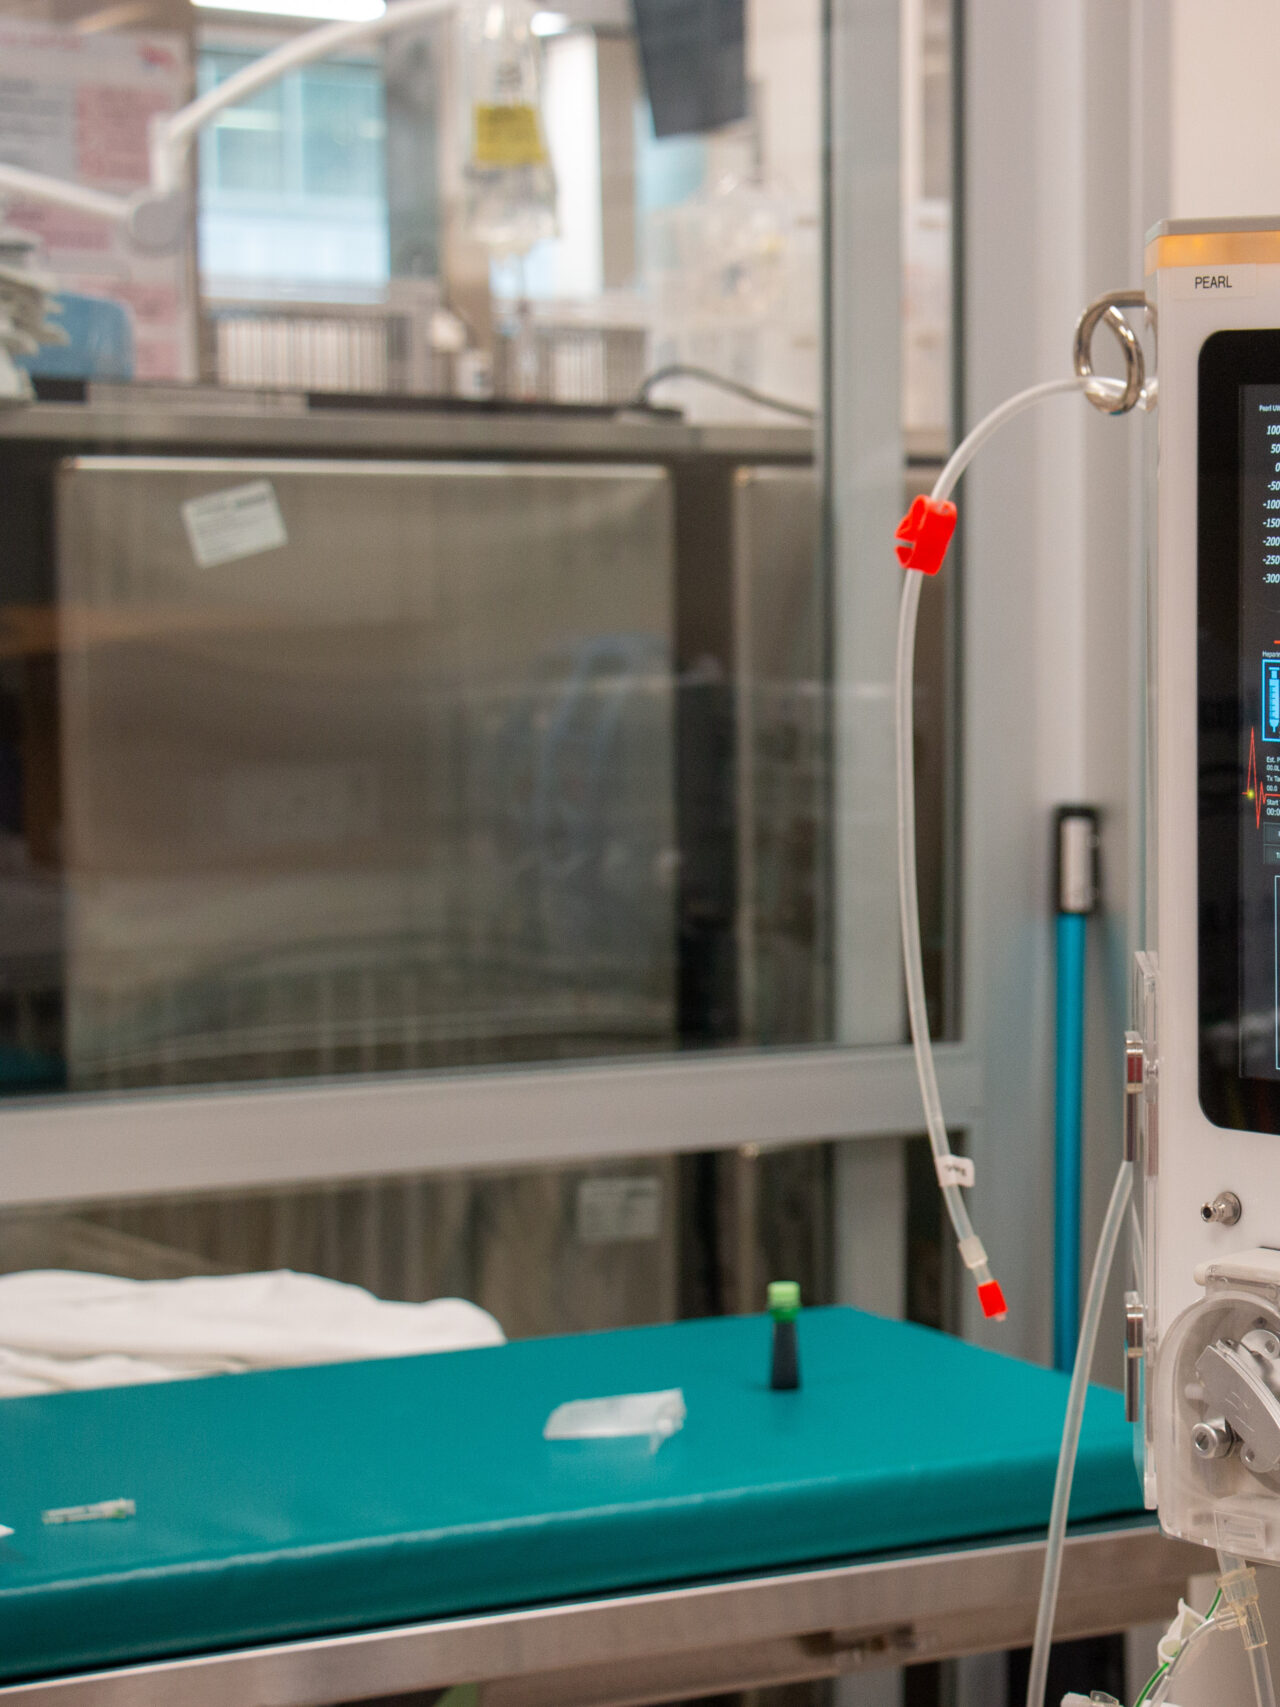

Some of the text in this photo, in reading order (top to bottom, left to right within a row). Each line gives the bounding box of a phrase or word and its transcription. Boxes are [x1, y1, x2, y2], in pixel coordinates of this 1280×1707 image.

[1194, 275, 1232, 288] PEARL
[1267, 425, 1280, 435] 100
[1270, 444, 1280, 454] 50
[1275, 463, 1280, 472] 0
[1267, 481, 1280, 491] -50
[1263, 500, 1280, 509] -100
[1262, 518, 1280, 528] -150
[1262, 537, 1280, 546] -200
[1262, 555, 1280, 565] -250
[1262, 574, 1280, 583] -300
